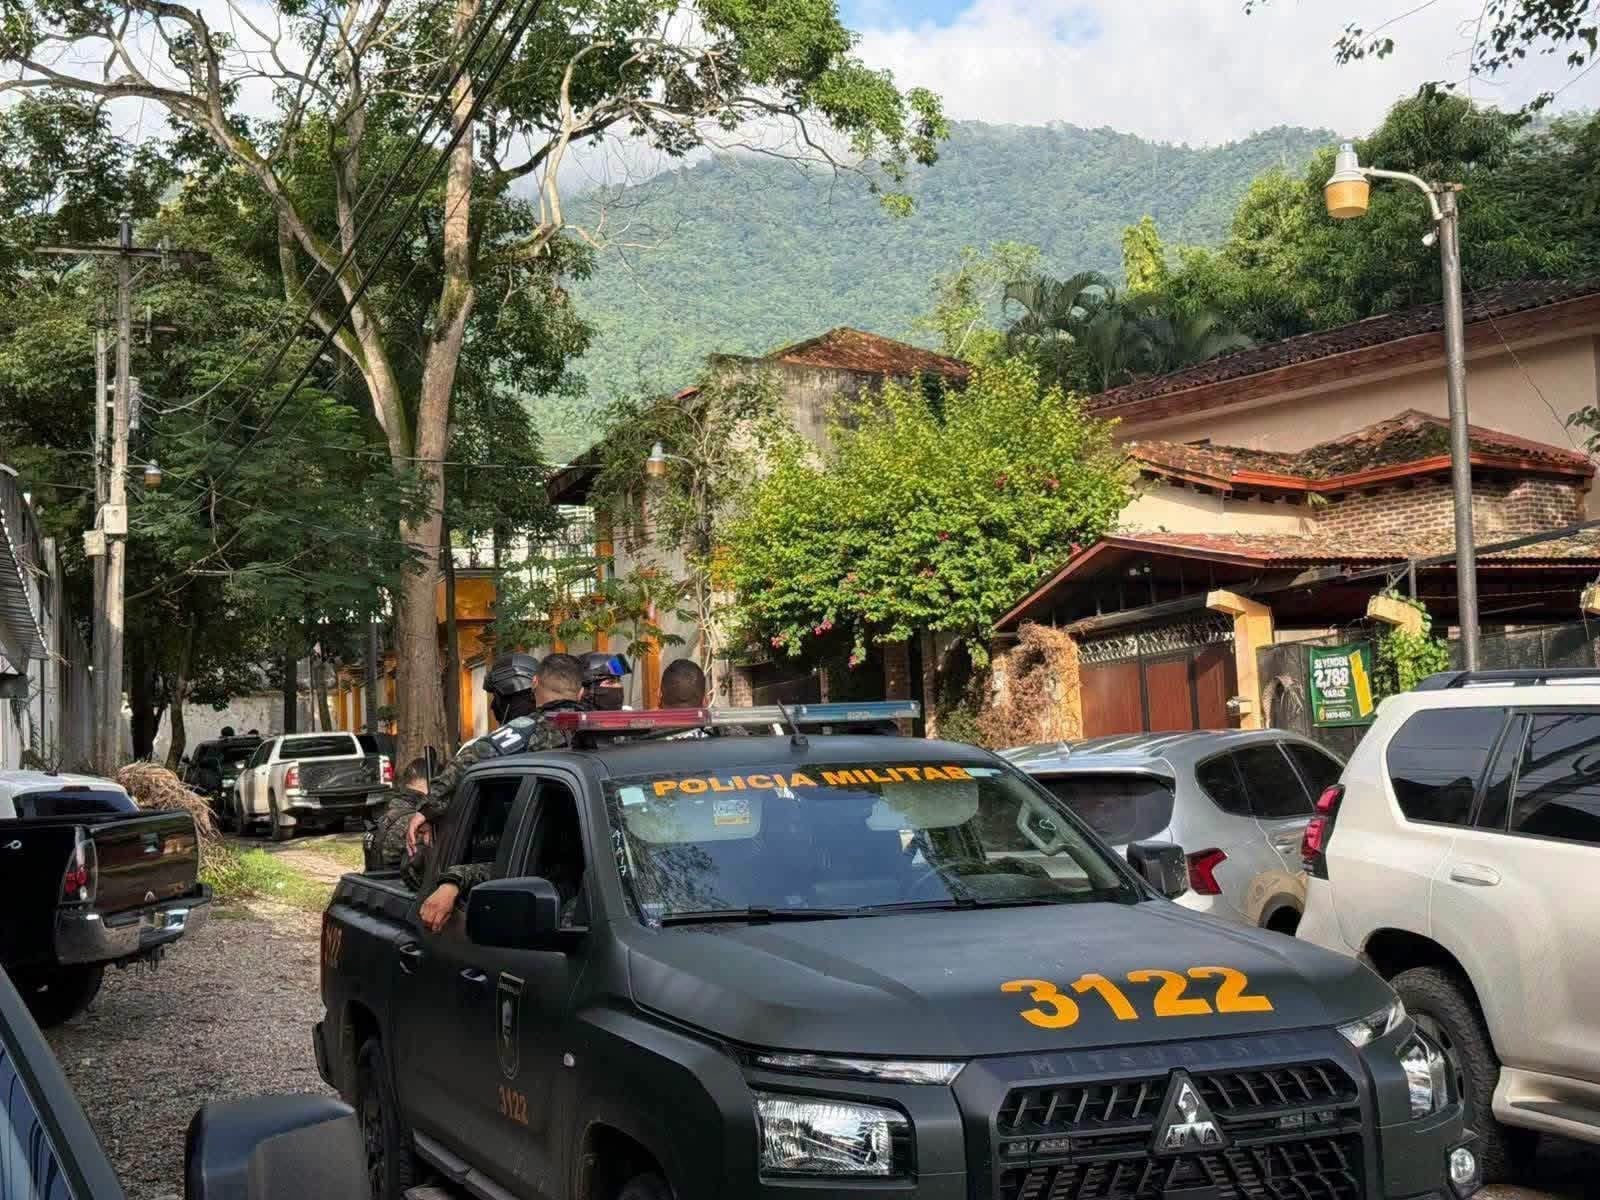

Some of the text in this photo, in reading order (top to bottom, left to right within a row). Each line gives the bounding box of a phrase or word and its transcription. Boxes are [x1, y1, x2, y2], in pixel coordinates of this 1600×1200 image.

[652, 766, 977, 797] POLICIA MILITAR
[1000, 966, 1275, 1029] 3122
[498, 1085, 529, 1126] 3122
